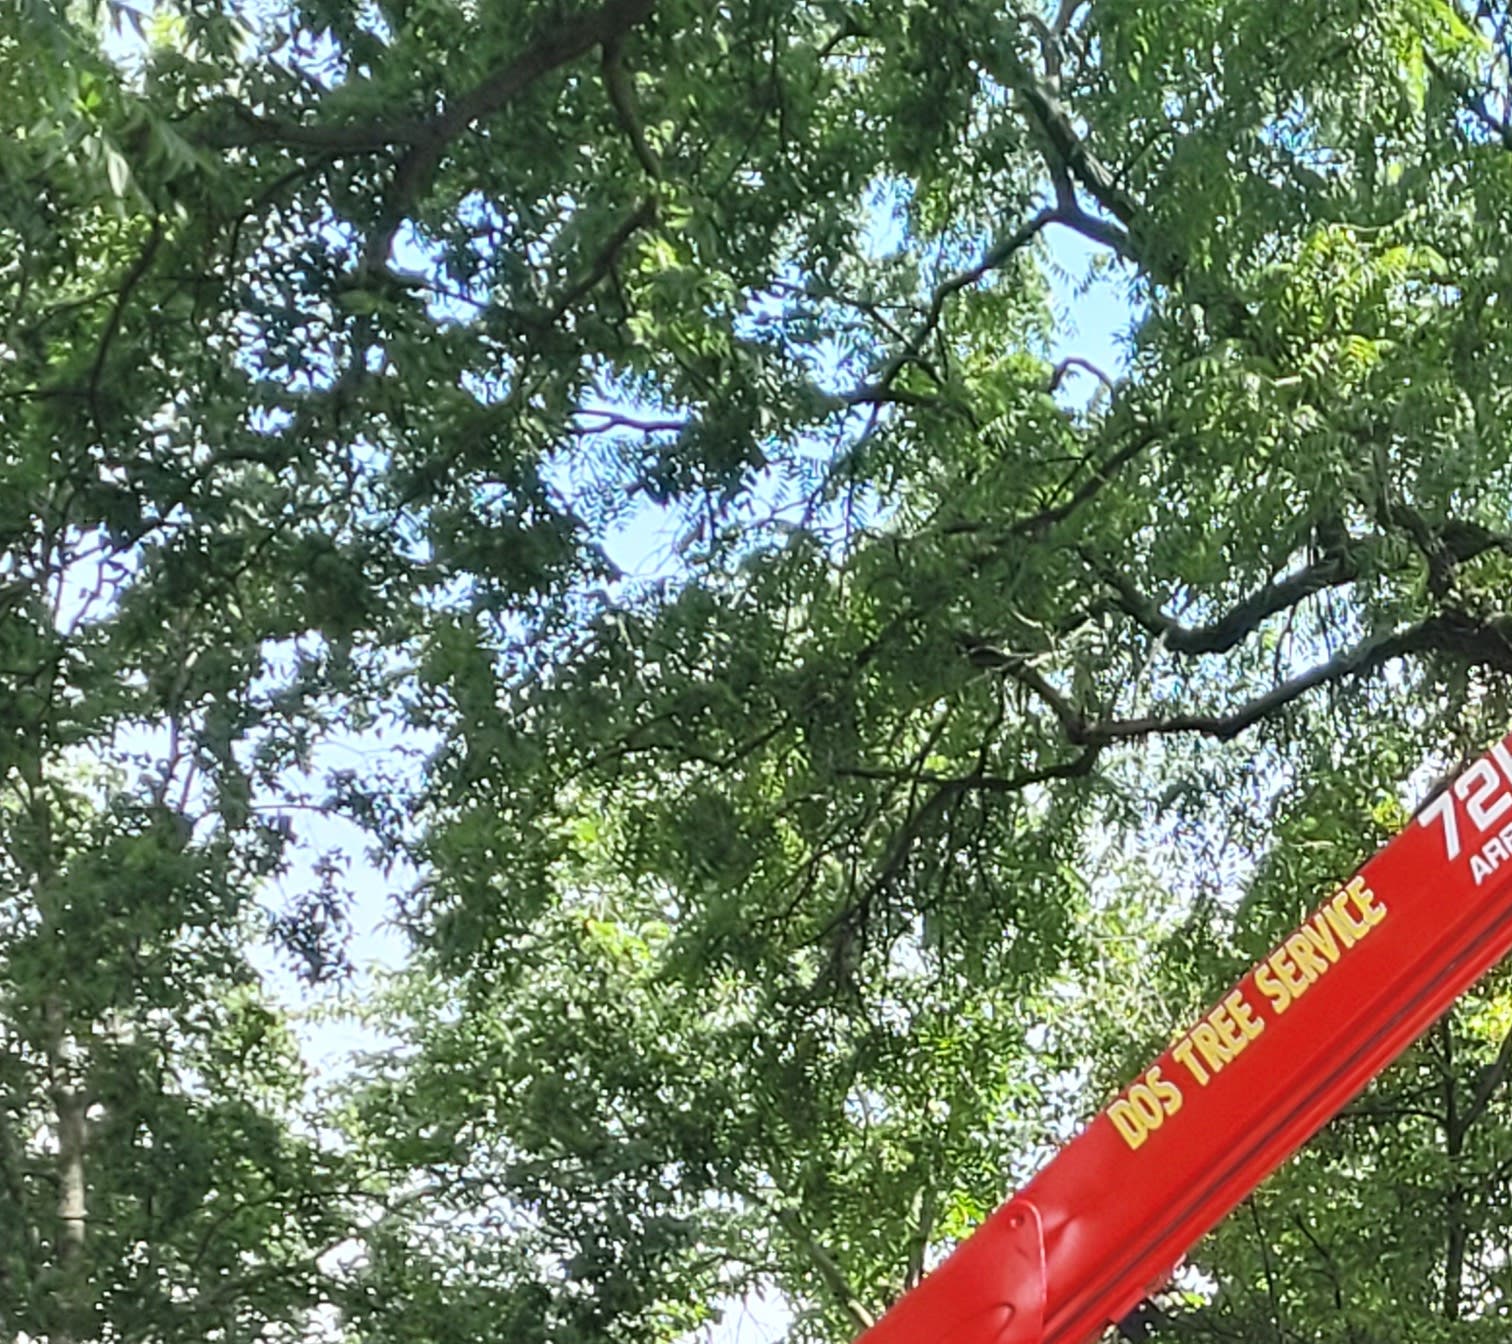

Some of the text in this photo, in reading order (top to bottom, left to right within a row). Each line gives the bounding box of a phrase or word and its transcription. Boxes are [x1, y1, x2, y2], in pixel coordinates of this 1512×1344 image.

[1106, 875, 1388, 1151] DOS TREE SERVICE
